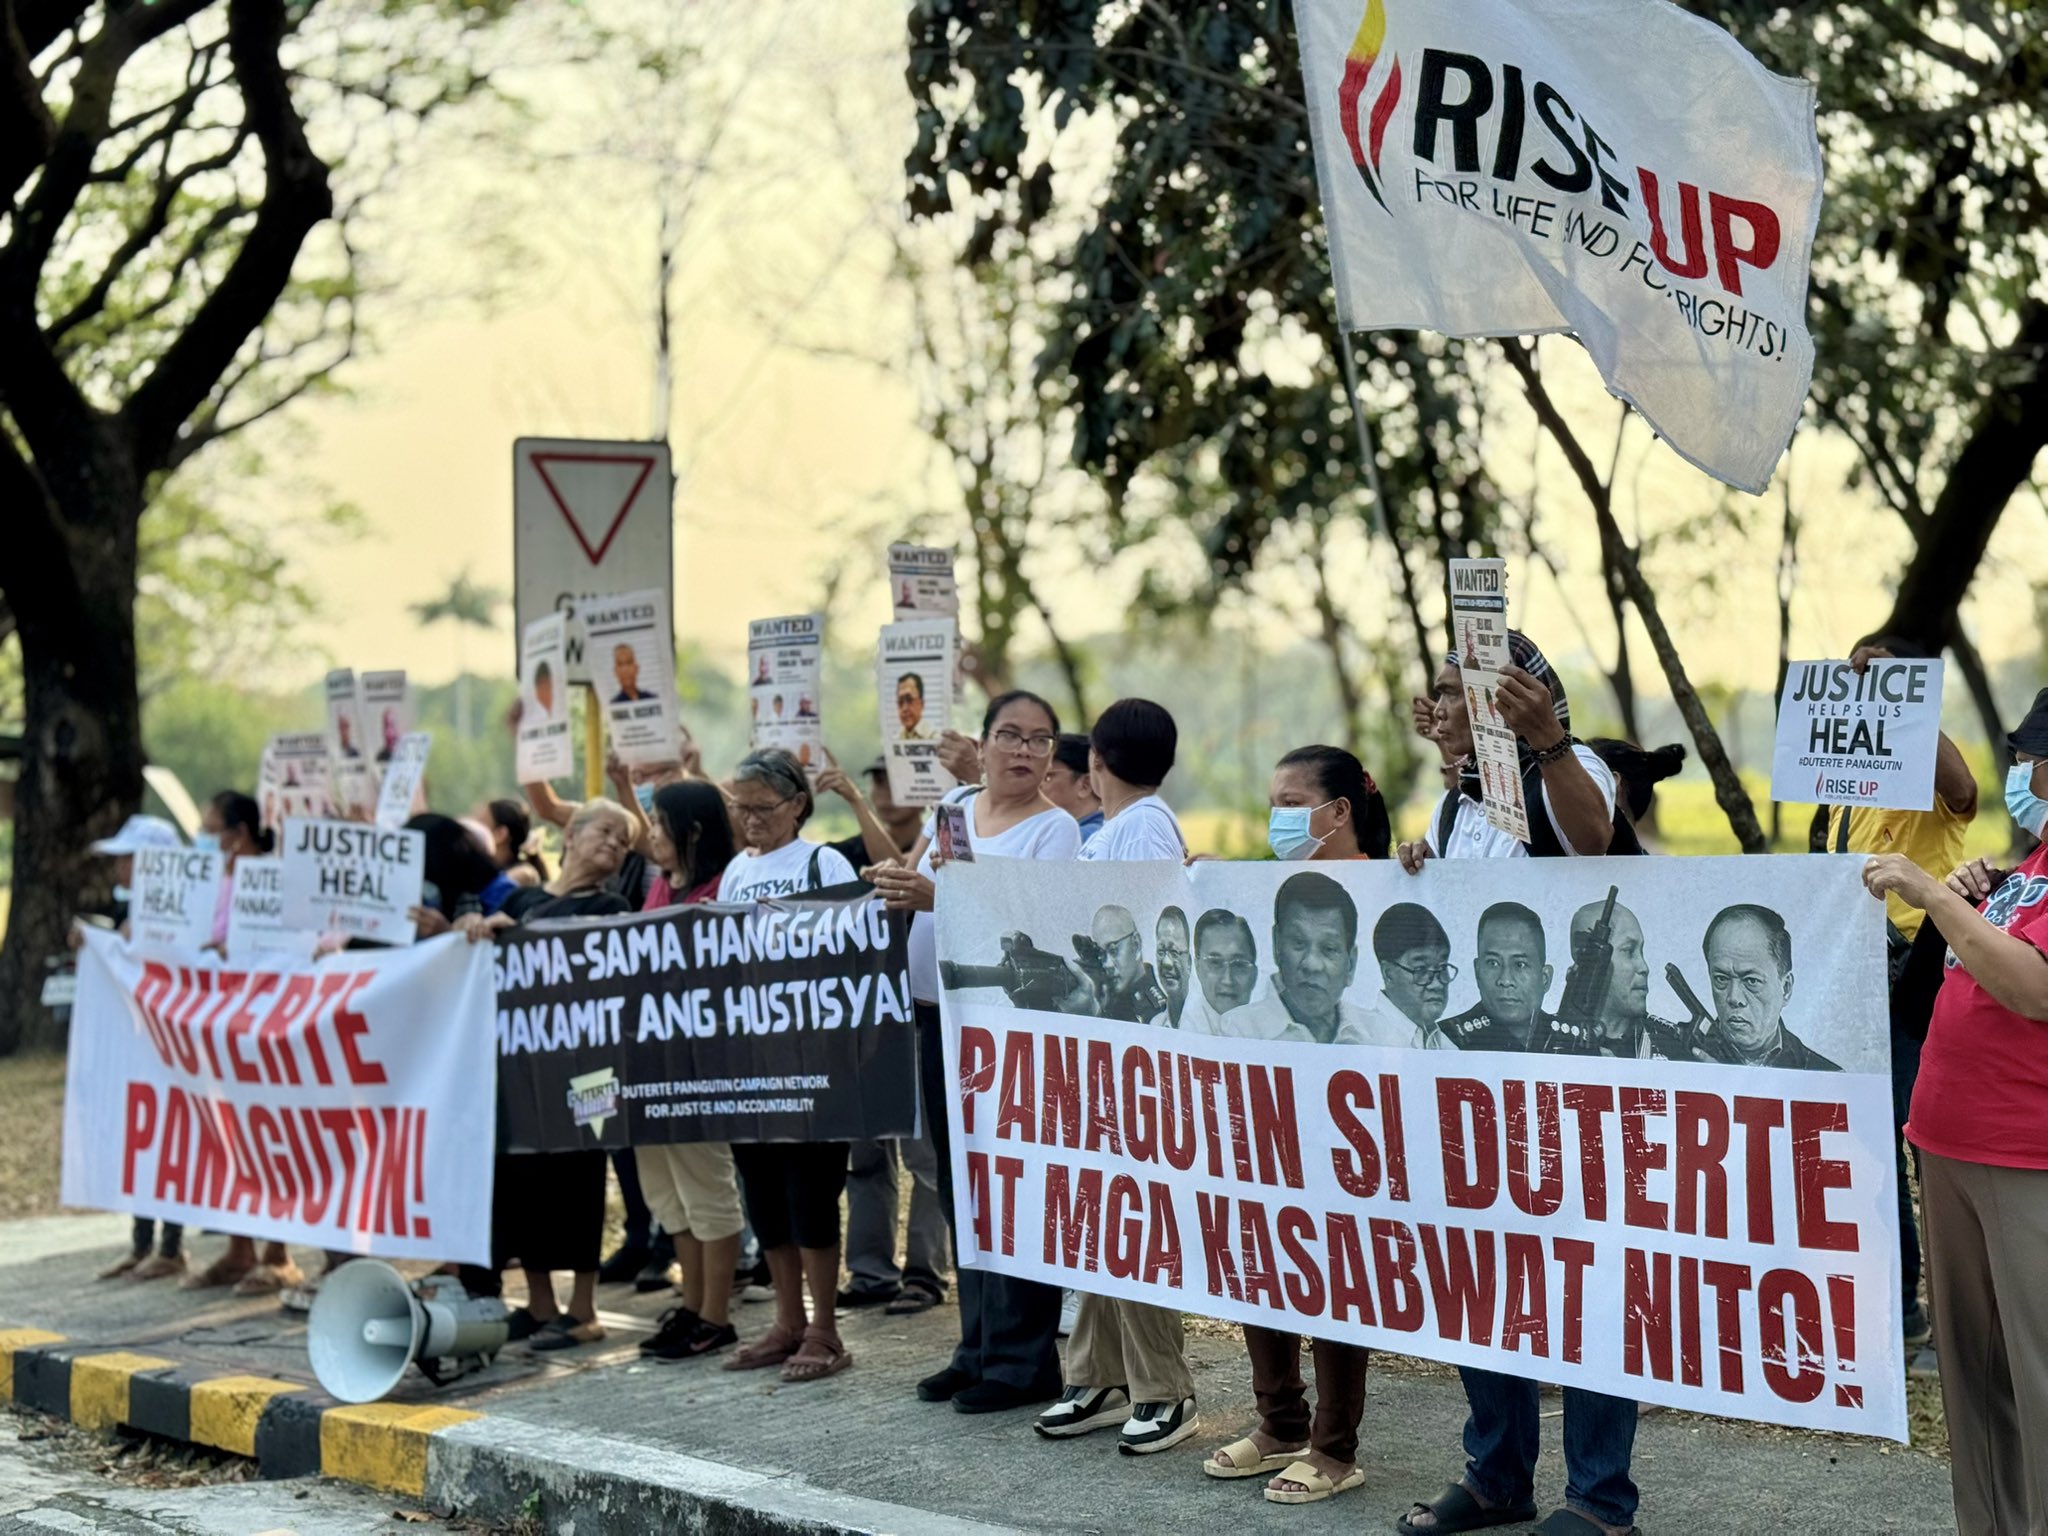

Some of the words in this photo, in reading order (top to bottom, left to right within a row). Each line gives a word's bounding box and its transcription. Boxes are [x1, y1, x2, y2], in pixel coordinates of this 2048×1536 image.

[1413, 48, 1630, 220] RISE
[1636, 166, 1781, 297] UP
[1415, 167, 1480, 210] FOR
[1493, 187, 1556, 238] LIFE
[1620, 241, 1672, 297] FO
[1675, 290, 1787, 361] RIGHTS!
[893, 551, 947, 564] WANTED
[1454, 568, 1499, 592] WANTED
[586, 604, 655, 626] WANTED
[751, 618, 814, 637] WANTED
[885, 634, 945, 652] WANTED
[1792, 664, 1928, 703] JUSTICE
[1807, 703, 1863, 716] HELPS
[1878, 705, 1902, 718] US
[1809, 718, 1892, 756] HEAL
[1798, 757, 1844, 768] #DUTERTE
[1845, 759, 1902, 771] PANAGUTIN
[1825, 779, 1856, 794] RISE
[1859, 781, 1878, 796] UP
[297, 825, 411, 864] JUSTICE
[138, 851, 212, 881] JUSTICE
[241, 867, 280, 891] DUTE
[320, 867, 388, 901] HEAL
[143, 887, 185, 916] HEAL
[235, 896, 281, 917] PANAG
[693, 899, 890, 969] HANGGANG
[637, 989, 716, 1044] ANG
[725, 969, 912, 1037] HUSTISYA!
[134, 960, 389, 1086] DUTERTE
[621, 1082, 673, 1099] DUTERTE
[734, 1076, 783, 1092] CAMPAIGN
[784, 1075, 831, 1090] NETWORK
[645, 1104, 670, 1119] FOR
[670, 1101, 712, 1117] JUSTCE
[713, 1099, 735, 1115] AND
[736, 1098, 815, 1114] ACCOUNTABILITY
[959, 1025, 1305, 1190] PANAGUTIN
[1327, 1069, 1410, 1202] SI
[1435, 1076, 1860, 1253] DUTERTE
[122, 1081, 431, 1239] PANAGUTIN!
[966, 1150, 1024, 1257] AT
[1043, 1163, 1183, 1290] MGA
[1196, 1191, 1595, 1365] KASABWAT
[1624, 1247, 1864, 1410] NITO!
